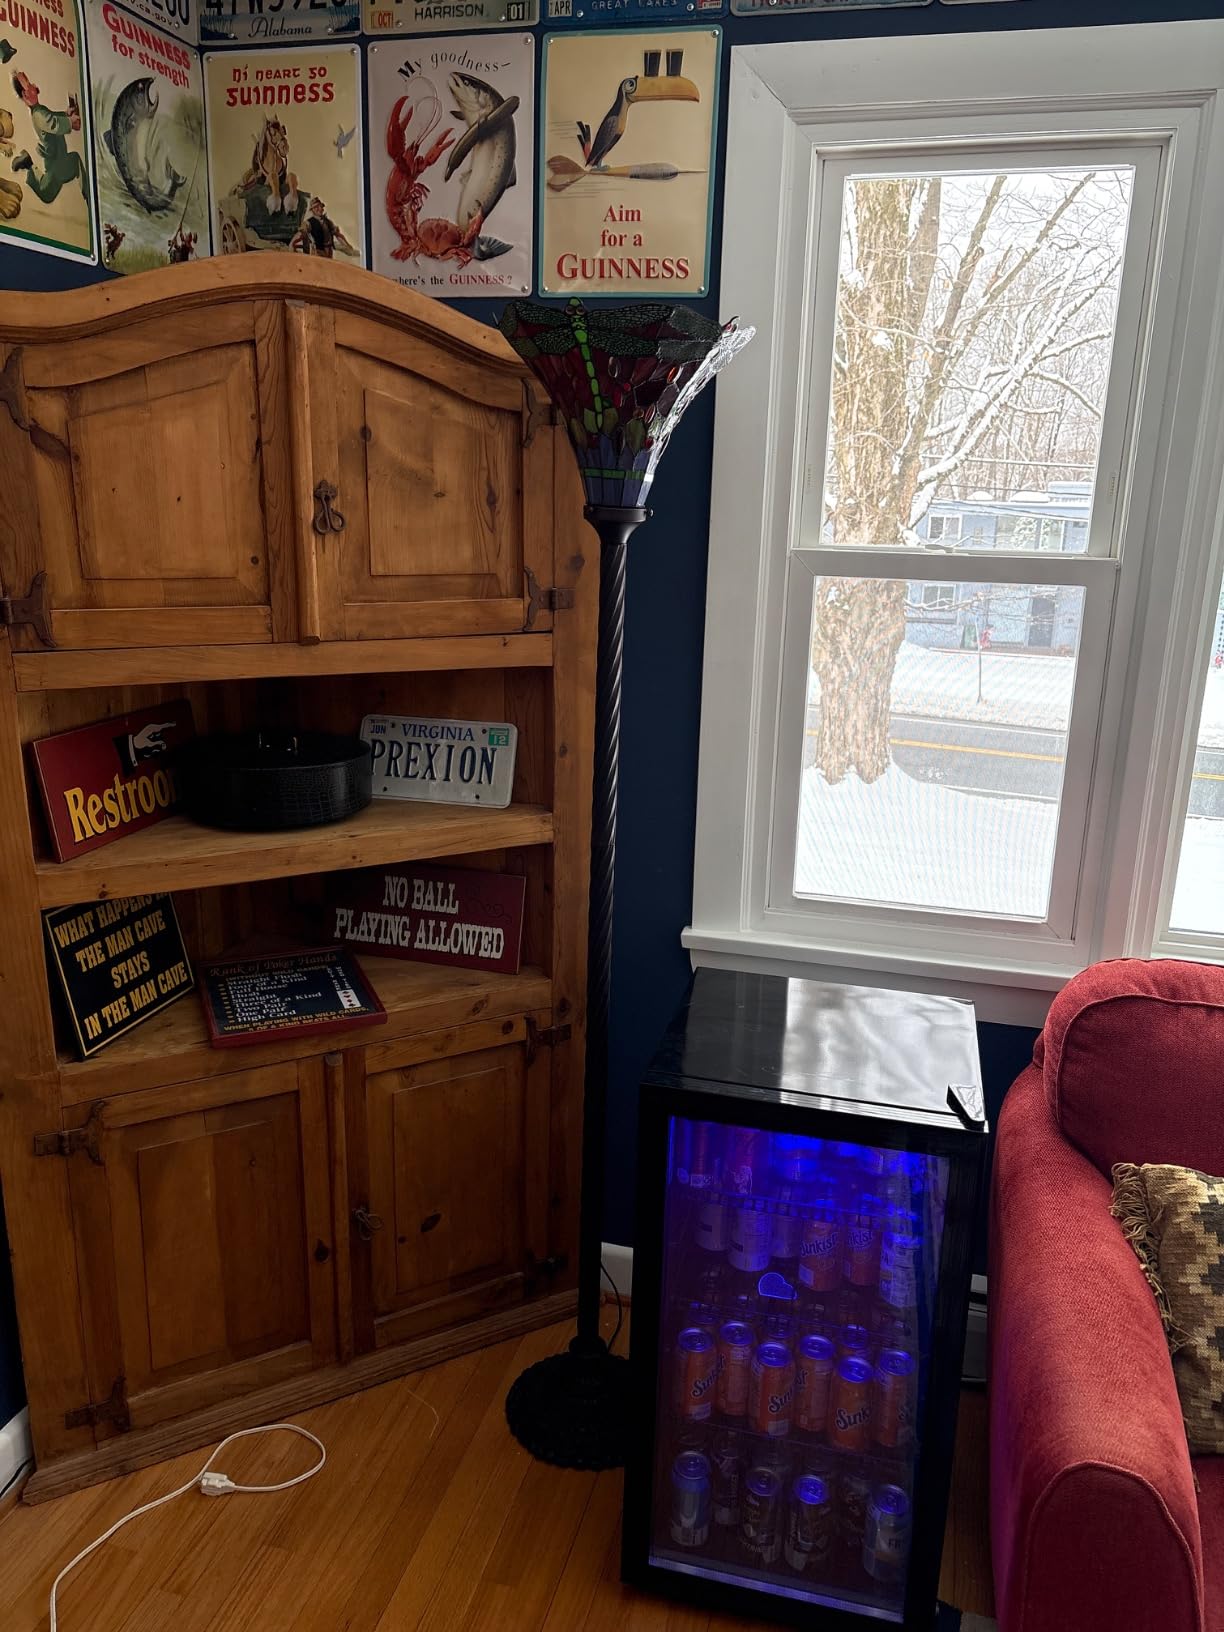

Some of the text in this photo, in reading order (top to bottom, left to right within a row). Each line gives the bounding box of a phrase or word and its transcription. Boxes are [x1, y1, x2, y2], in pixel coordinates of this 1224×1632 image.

[415, 4, 485, 21] HARRISON
[509, 4, 524, 20] 01
[554, 0, 571, 16] APR
[248, 17, 313, 38] Alabama
[377, 12, 393, 28] OCT
[103, 3, 191, 70] GUINNESS
[112, 34, 190, 89] for strength
[397, 58, 422, 79] My
[603, 204, 642, 222] Aim
[600, 229, 642, 247] for a
[556, 253, 690, 279] GUINNESS
[392, 275, 426, 286] here's
[430, 276, 445, 286] the
[402, 723, 475, 742] VIRGINIA
[371, 739, 498, 785] PREXION
[382, 875, 459, 914] NO BALL
[54, 910, 95, 949] WHAT
[75, 909, 167, 973] THE MAN CAVE
[334, 908, 505, 960] PLAYING ALLOWED
[111, 951, 150, 989] STAYS
[84, 961, 188, 1040] IN THE MAN CAVE
